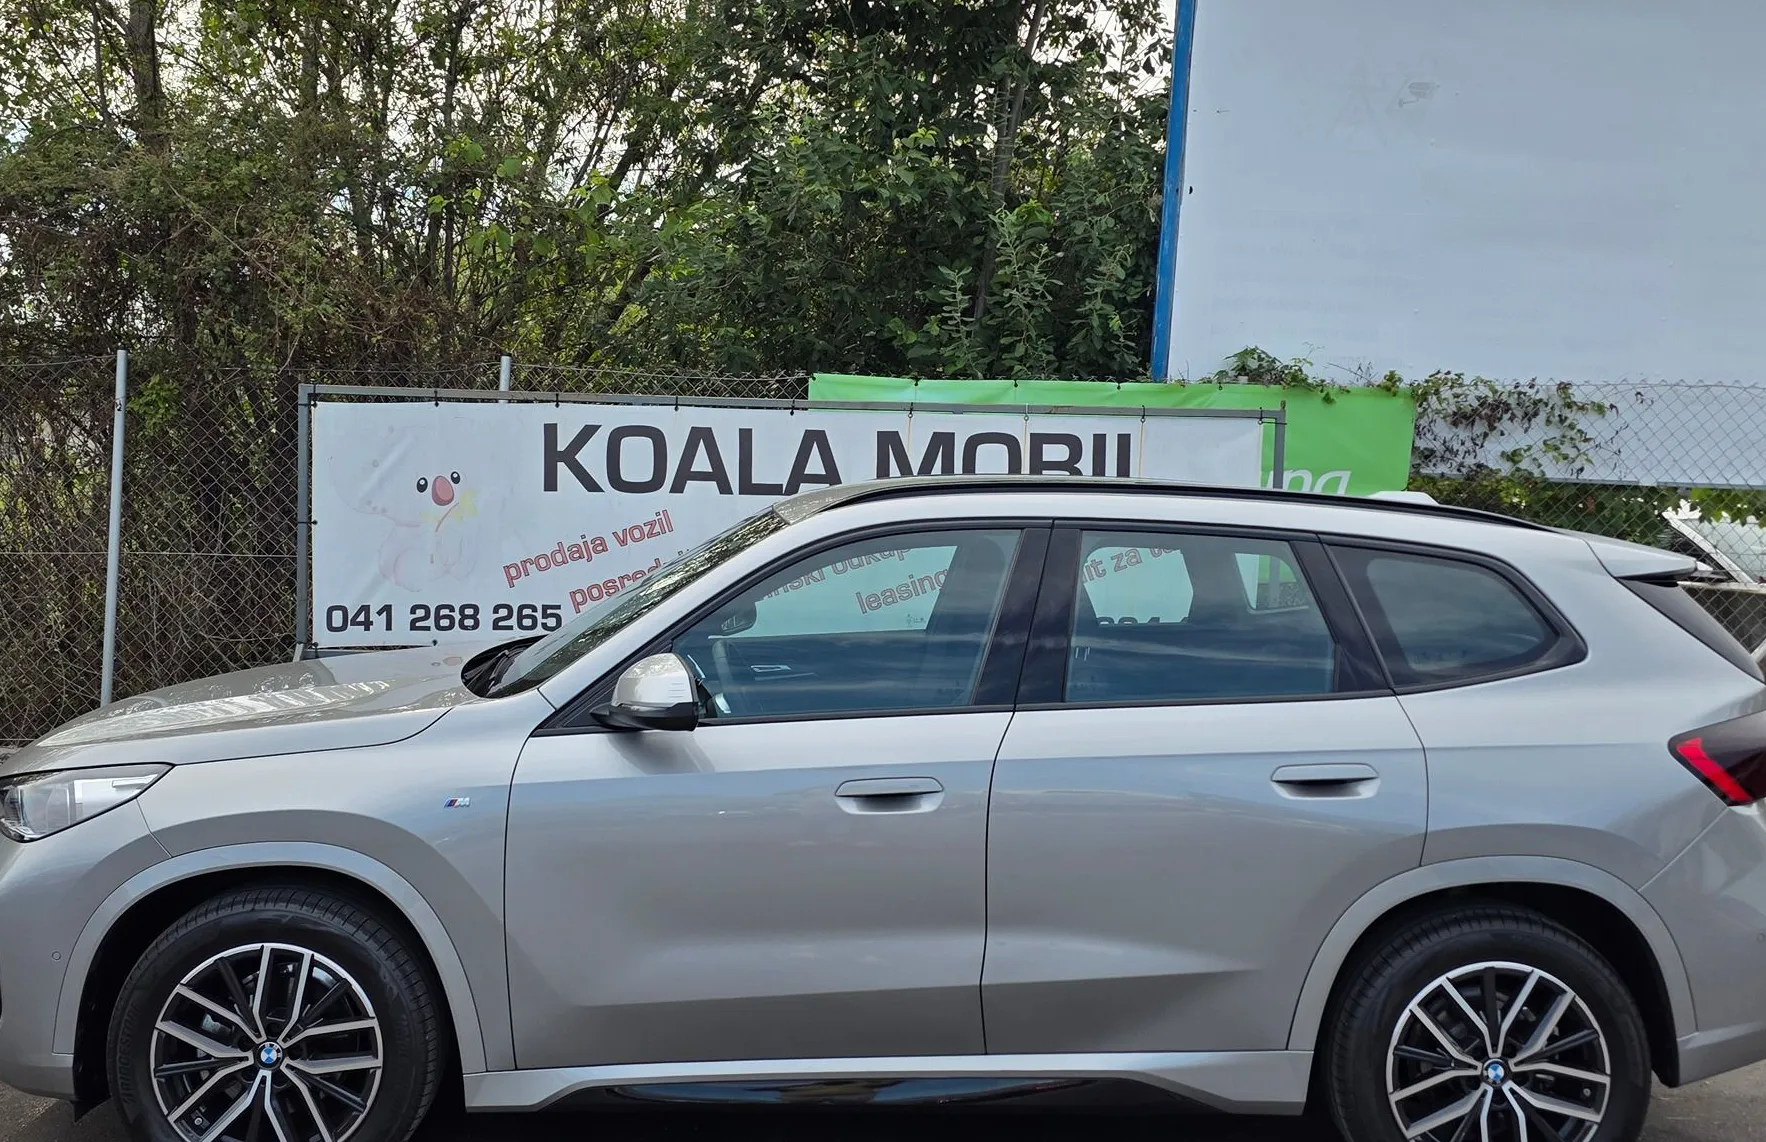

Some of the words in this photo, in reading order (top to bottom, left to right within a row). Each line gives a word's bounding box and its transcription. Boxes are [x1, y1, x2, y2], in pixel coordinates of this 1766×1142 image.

[543, 422, 842, 496] KOALA
[503, 534, 608, 588] prodaja
[612, 510, 674, 547] vozil
[1111, 548, 1143, 573] za
[326, 603, 393, 633] 041
[409, 603, 480, 632] 268
[492, 603, 563, 633] 265
